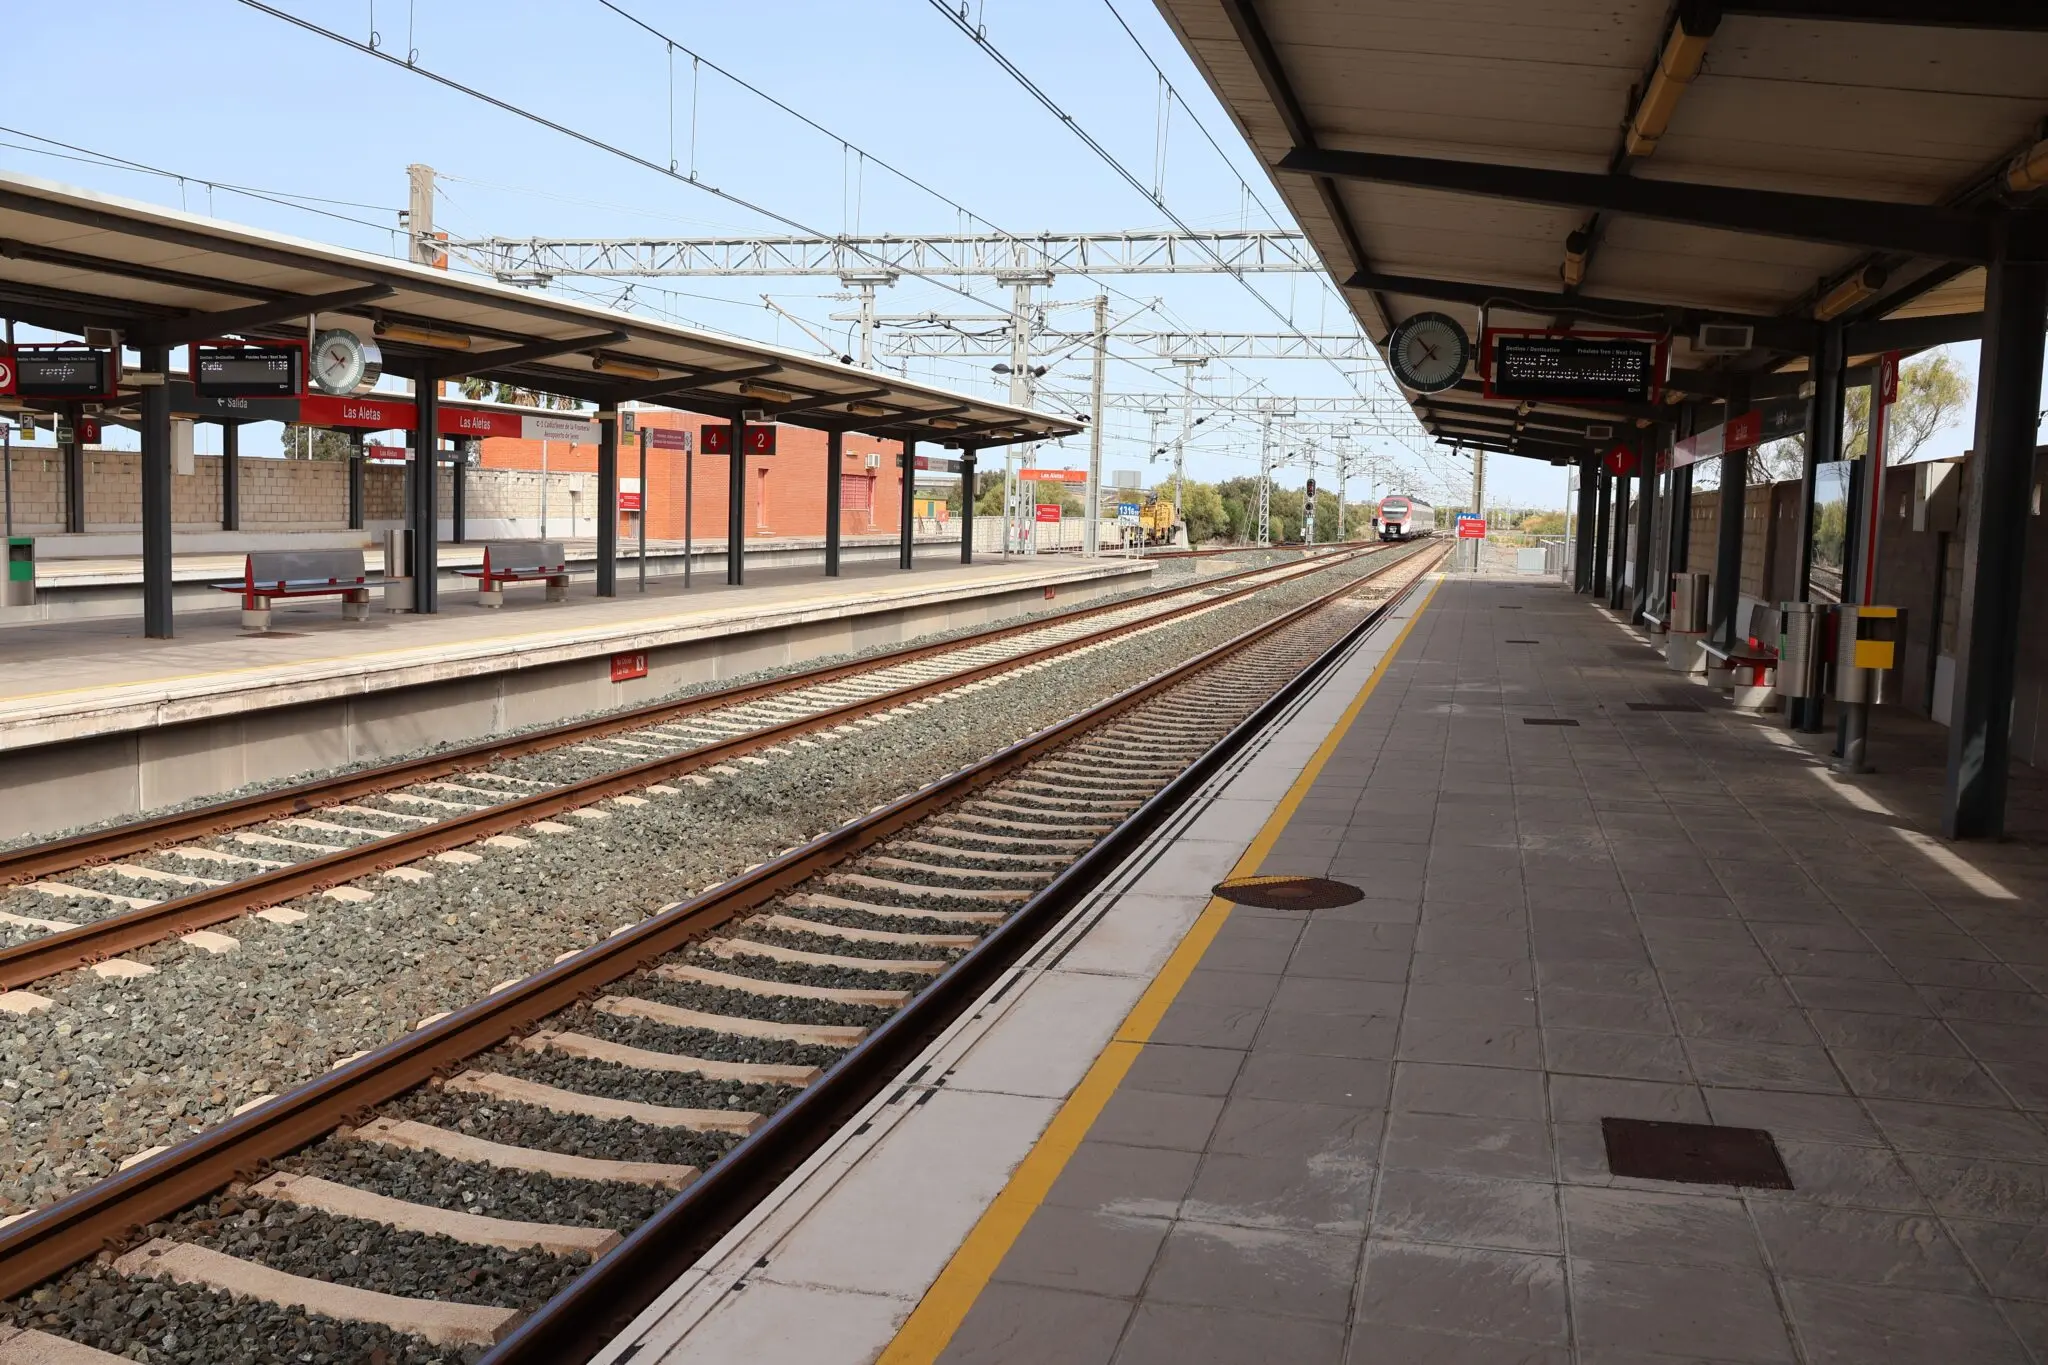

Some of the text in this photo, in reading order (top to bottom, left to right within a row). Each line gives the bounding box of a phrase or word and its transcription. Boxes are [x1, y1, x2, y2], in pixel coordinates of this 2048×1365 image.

[228, 398, 248, 408] Salida
[343, 404, 381, 421] Las Aletas
[460, 415, 491, 430] Las Aletas
[87, 425, 93, 438] 6
[710, 433, 717, 447] 4
[757, 433, 765, 447] 2
[1616, 452, 1622, 468] 1
